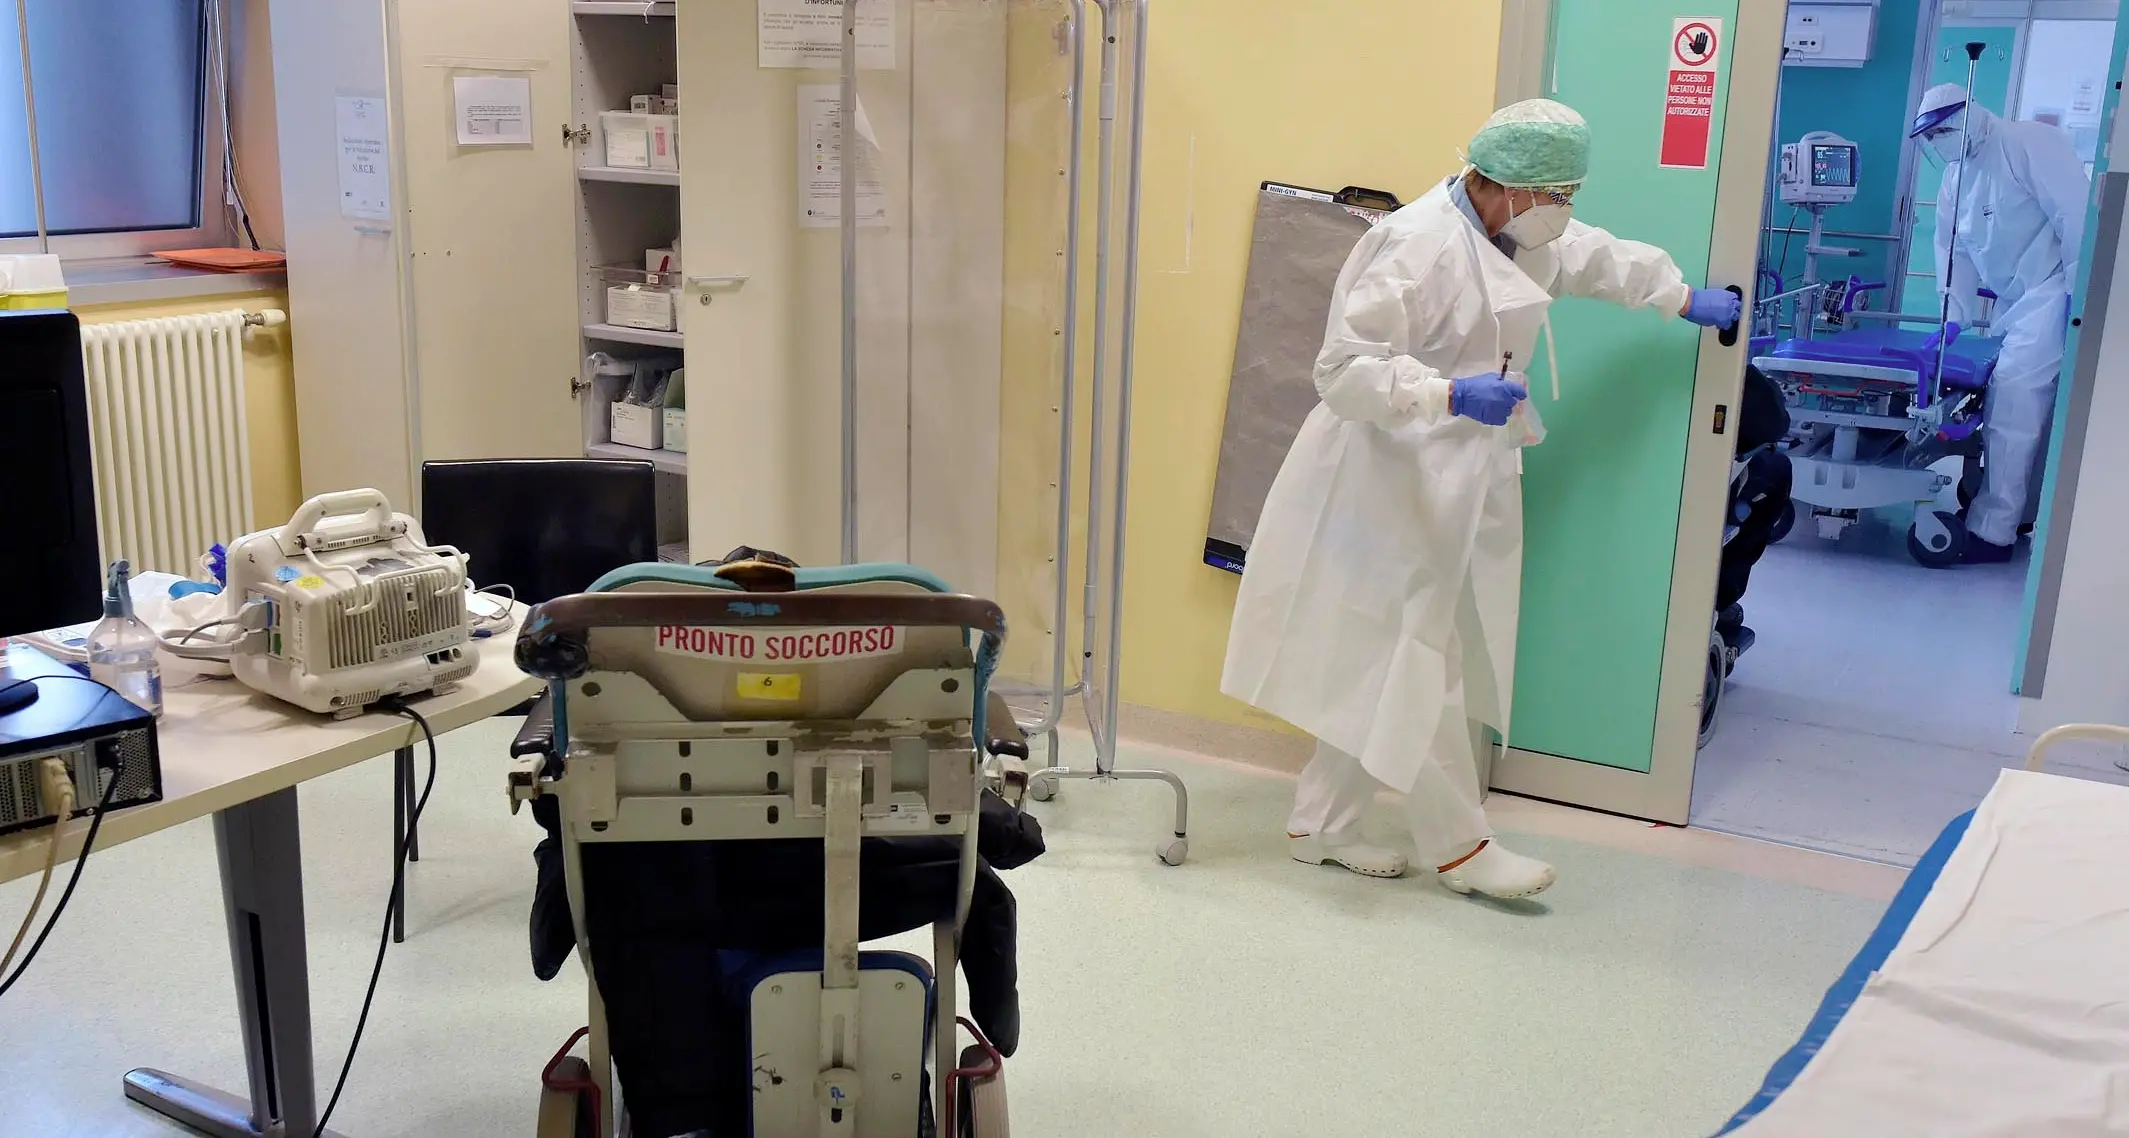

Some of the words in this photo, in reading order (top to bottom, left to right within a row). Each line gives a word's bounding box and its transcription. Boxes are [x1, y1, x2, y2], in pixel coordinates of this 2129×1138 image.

[1677, 74, 1707, 82] ACCESSO
[1670, 84, 1695, 93] VIETATO
[1695, 86, 1712, 94] ALLE
[1667, 95, 1697, 104] PERSONE
[1697, 97, 1712, 105] NON
[1666, 107, 1710, 116] AUTORIZZATE
[658, 624, 754, 659] PRONTO
[764, 624, 894, 660] SOCCORSO
[763, 677, 772, 686] 6
